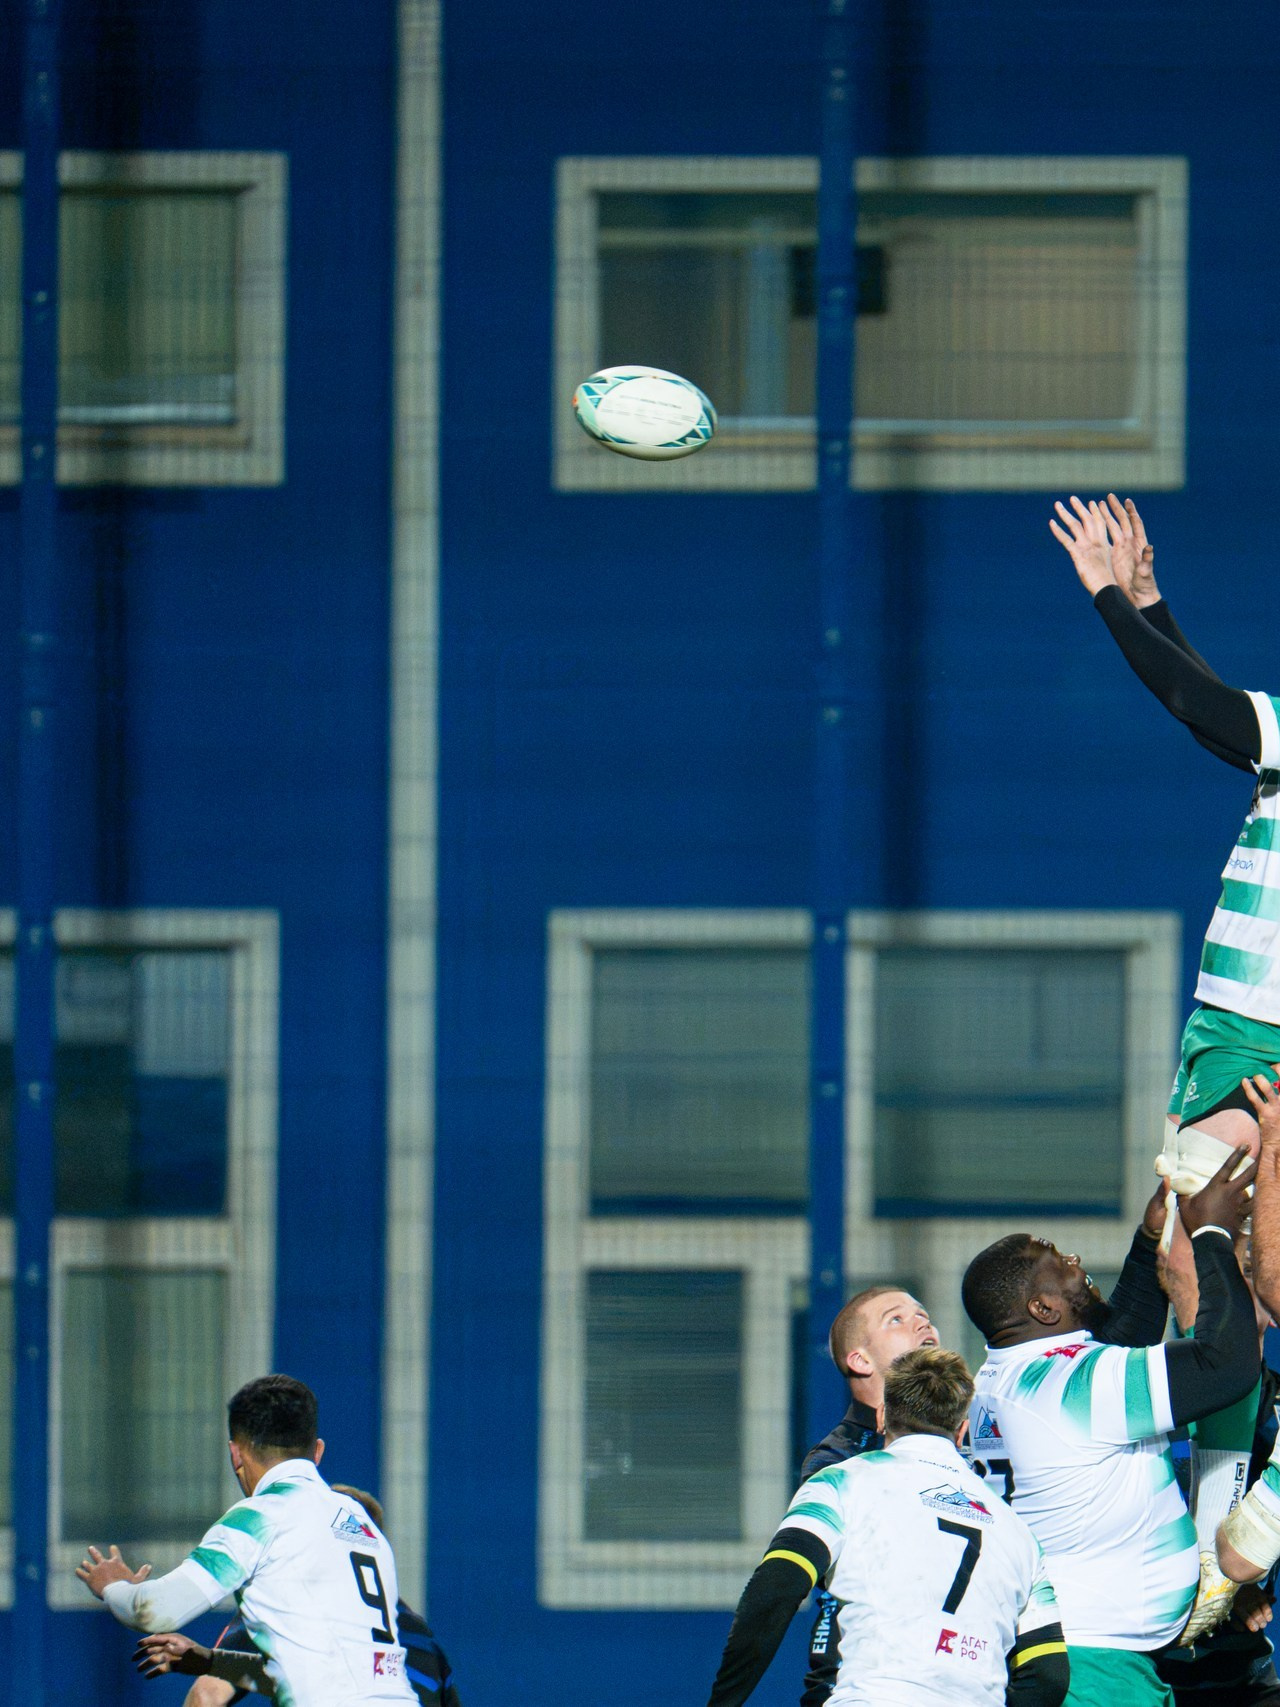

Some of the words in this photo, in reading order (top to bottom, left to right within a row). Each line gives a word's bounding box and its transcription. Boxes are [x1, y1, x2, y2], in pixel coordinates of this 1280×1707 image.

[937, 1516, 982, 1615] 7
[349, 1551, 395, 1645] 9
[960, 1647, 978, 1661] РФ
[961, 1634, 988, 1651] АГАТ
